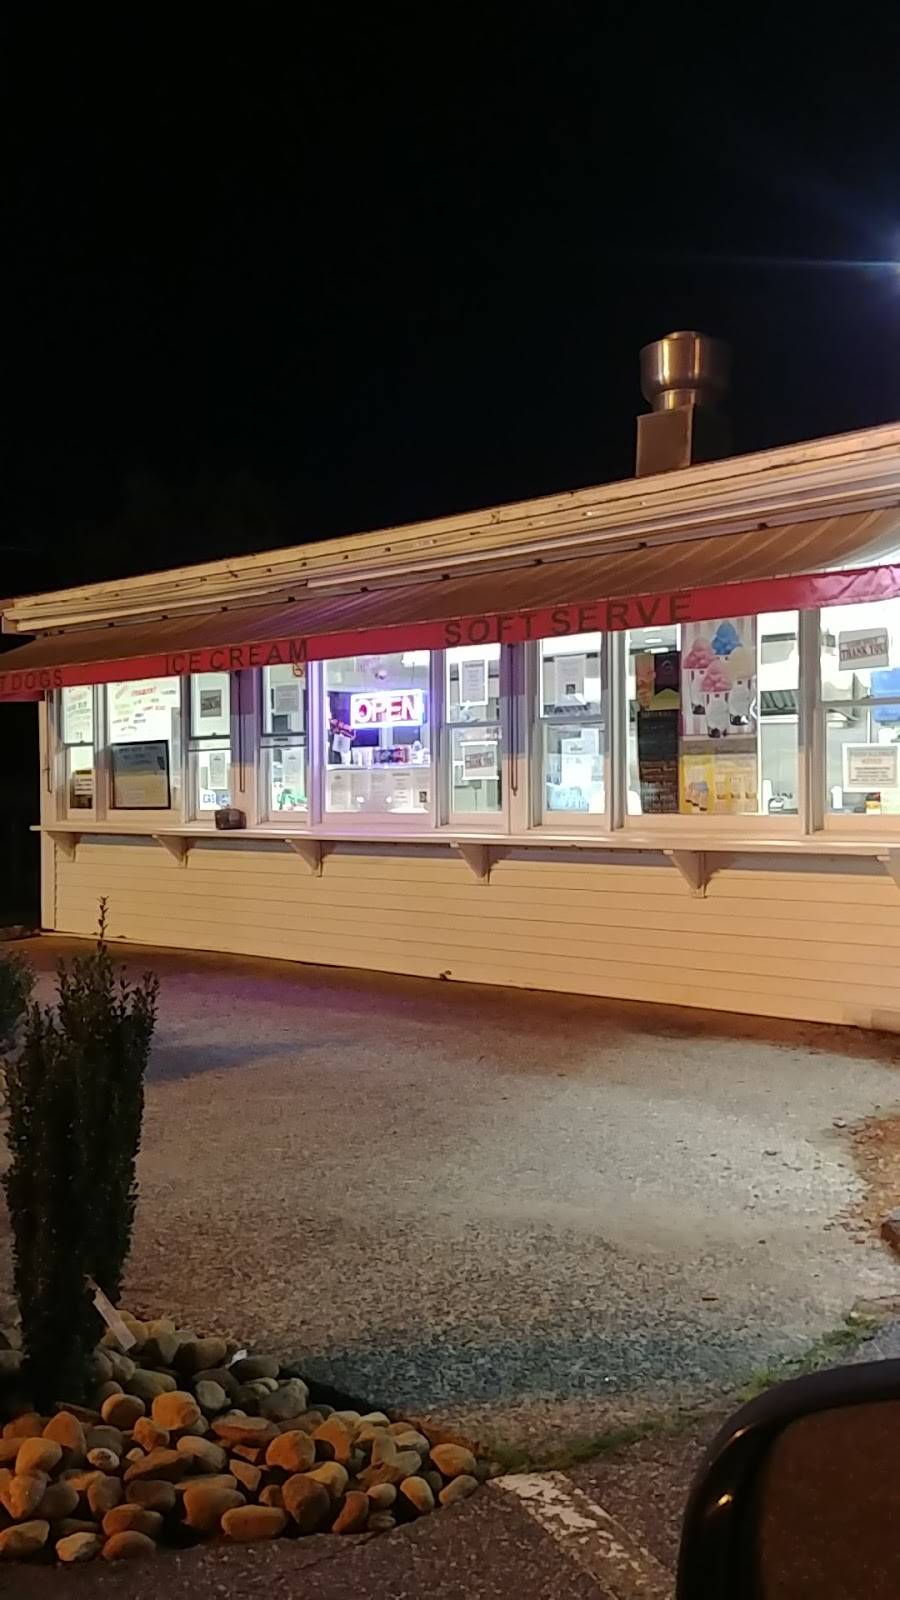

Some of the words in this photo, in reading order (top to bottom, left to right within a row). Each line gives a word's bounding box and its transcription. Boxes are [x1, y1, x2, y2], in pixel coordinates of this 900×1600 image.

[443, 614, 538, 646] SOFT
[551, 593, 692, 635] SERVE
[165, 653, 201, 676] ICE
[209, 639, 308, 670] CREAM
[11, 669, 63, 690] DOGS
[355, 695, 419, 723] OPEN
